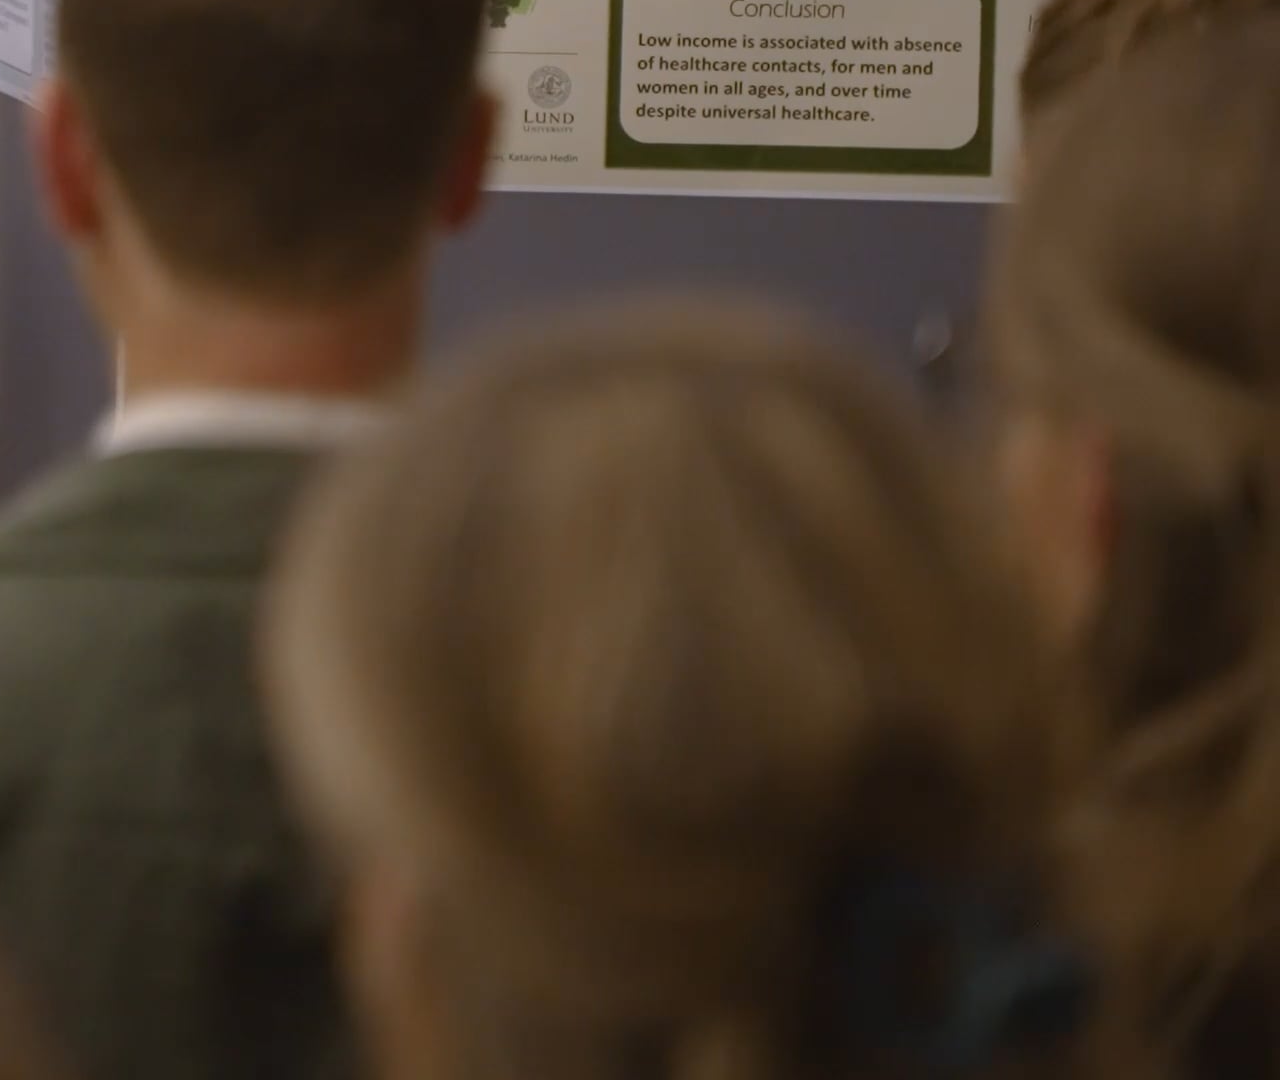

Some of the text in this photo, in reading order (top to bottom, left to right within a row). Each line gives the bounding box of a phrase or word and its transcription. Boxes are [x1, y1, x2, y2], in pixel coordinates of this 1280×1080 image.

[730, 0, 845, 19] Conclusion
[639, 33, 962, 52] Low income is associated with absence
[637, 56, 933, 76] of healthcare contacts, for men and
[637, 80, 911, 99] women in all ages, and over time
[524, 109, 574, 124] LUND
[636, 103, 874, 122] despite universal healthcare.
